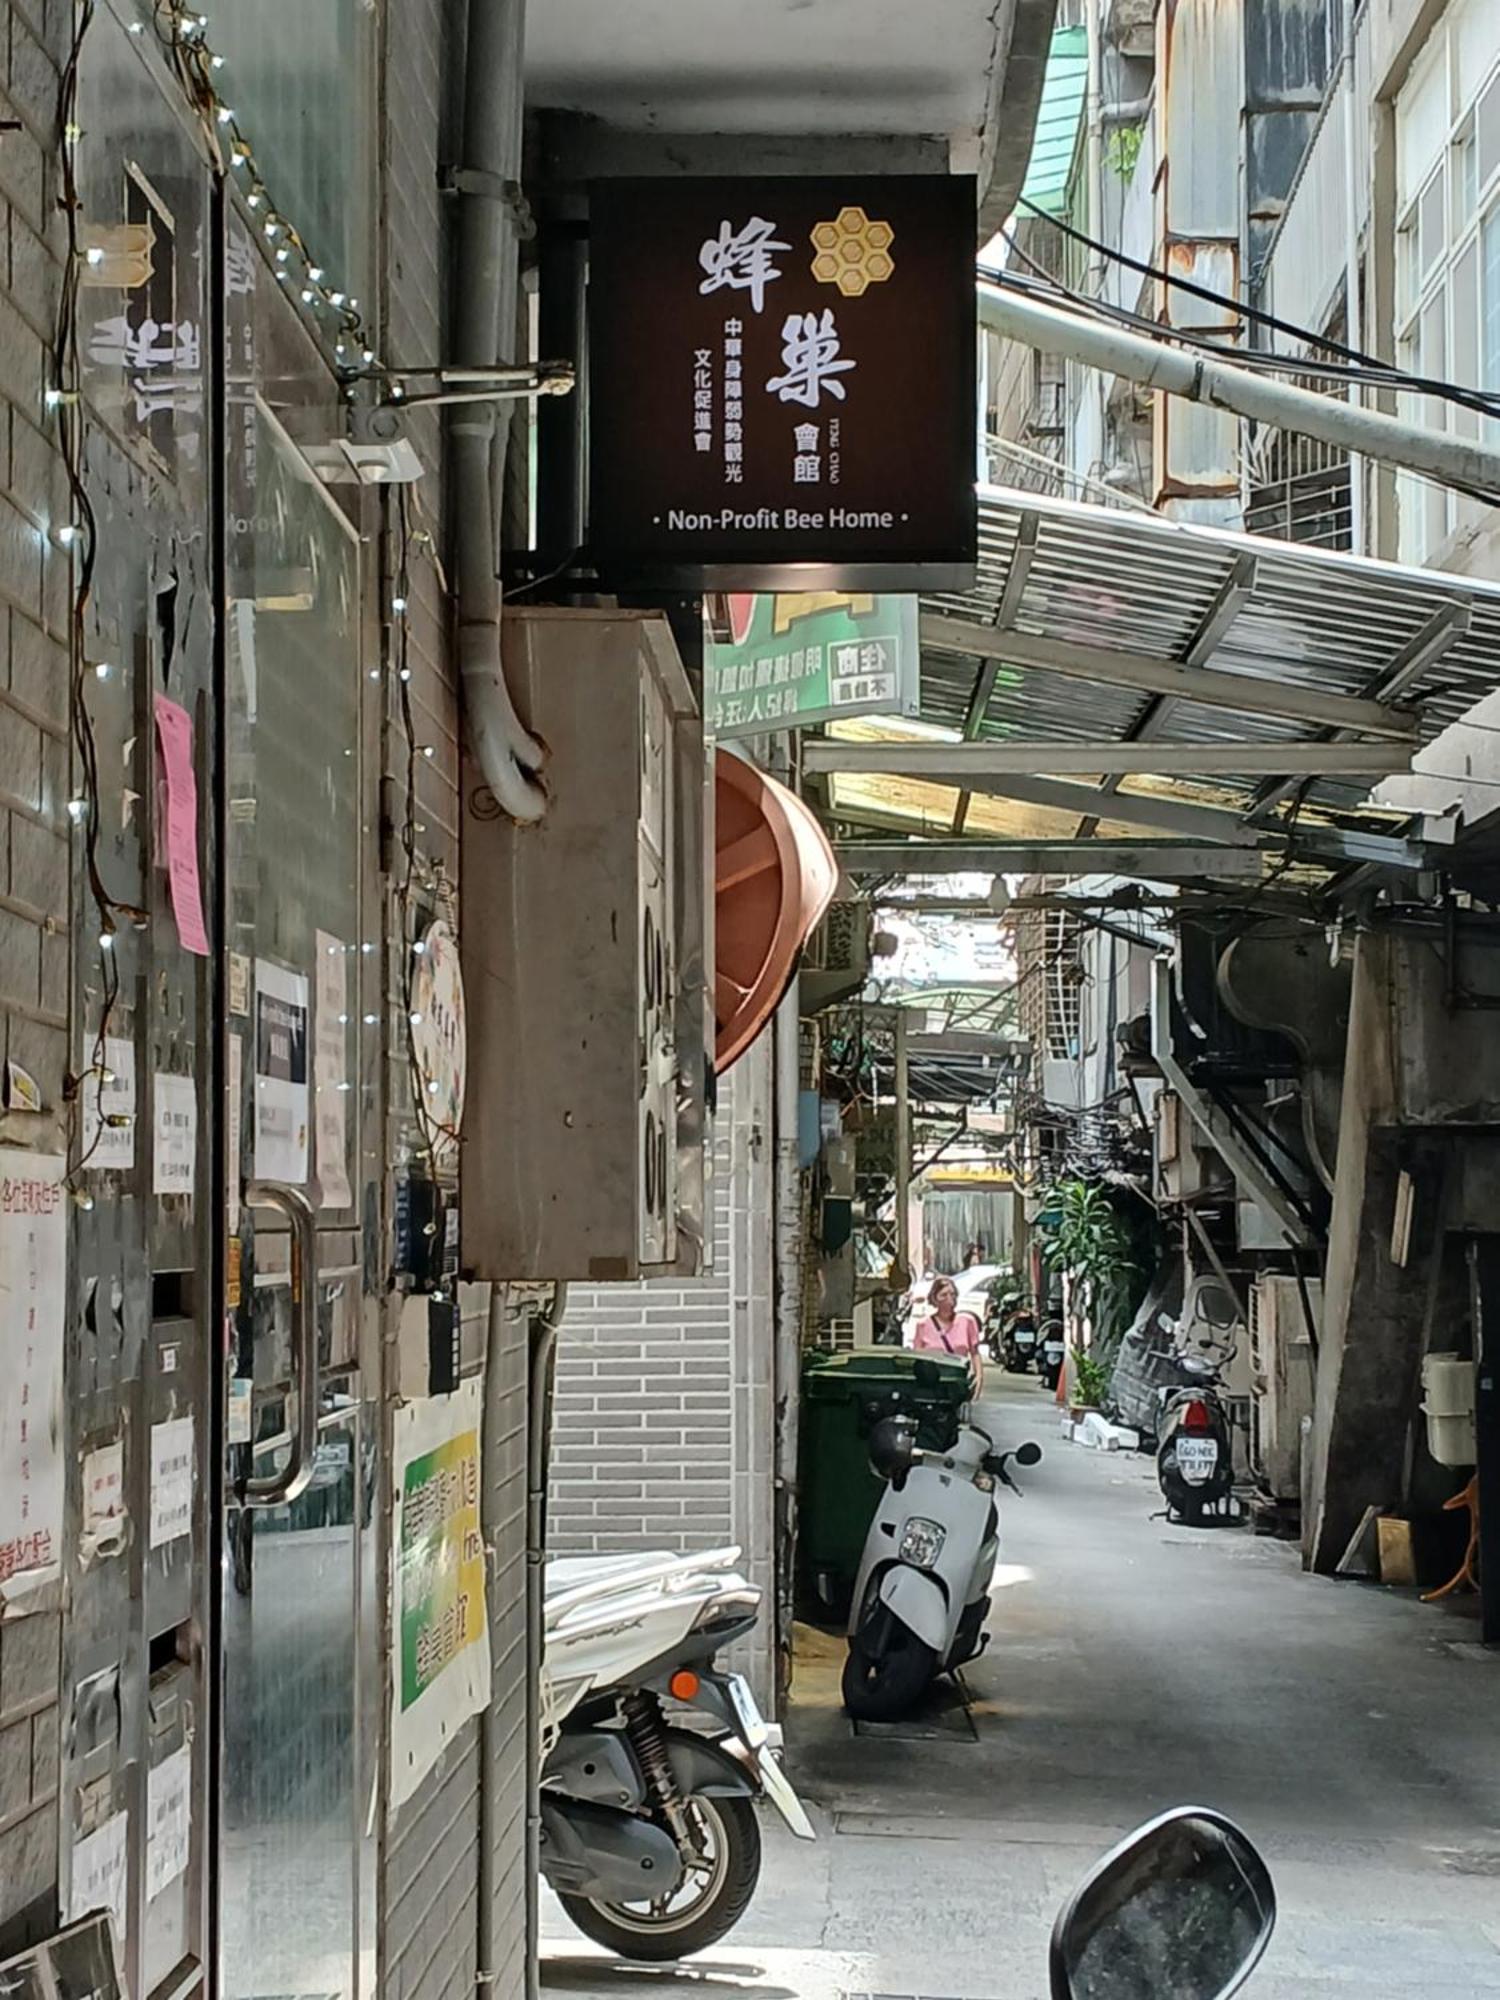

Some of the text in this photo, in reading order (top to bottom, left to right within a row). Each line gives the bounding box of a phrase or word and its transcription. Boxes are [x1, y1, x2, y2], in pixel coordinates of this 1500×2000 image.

[693, 348, 712, 452] 文化促進會
[793, 422, 820, 483] 會館
[668, 508, 893, 530] Non-Profit Bee Home
